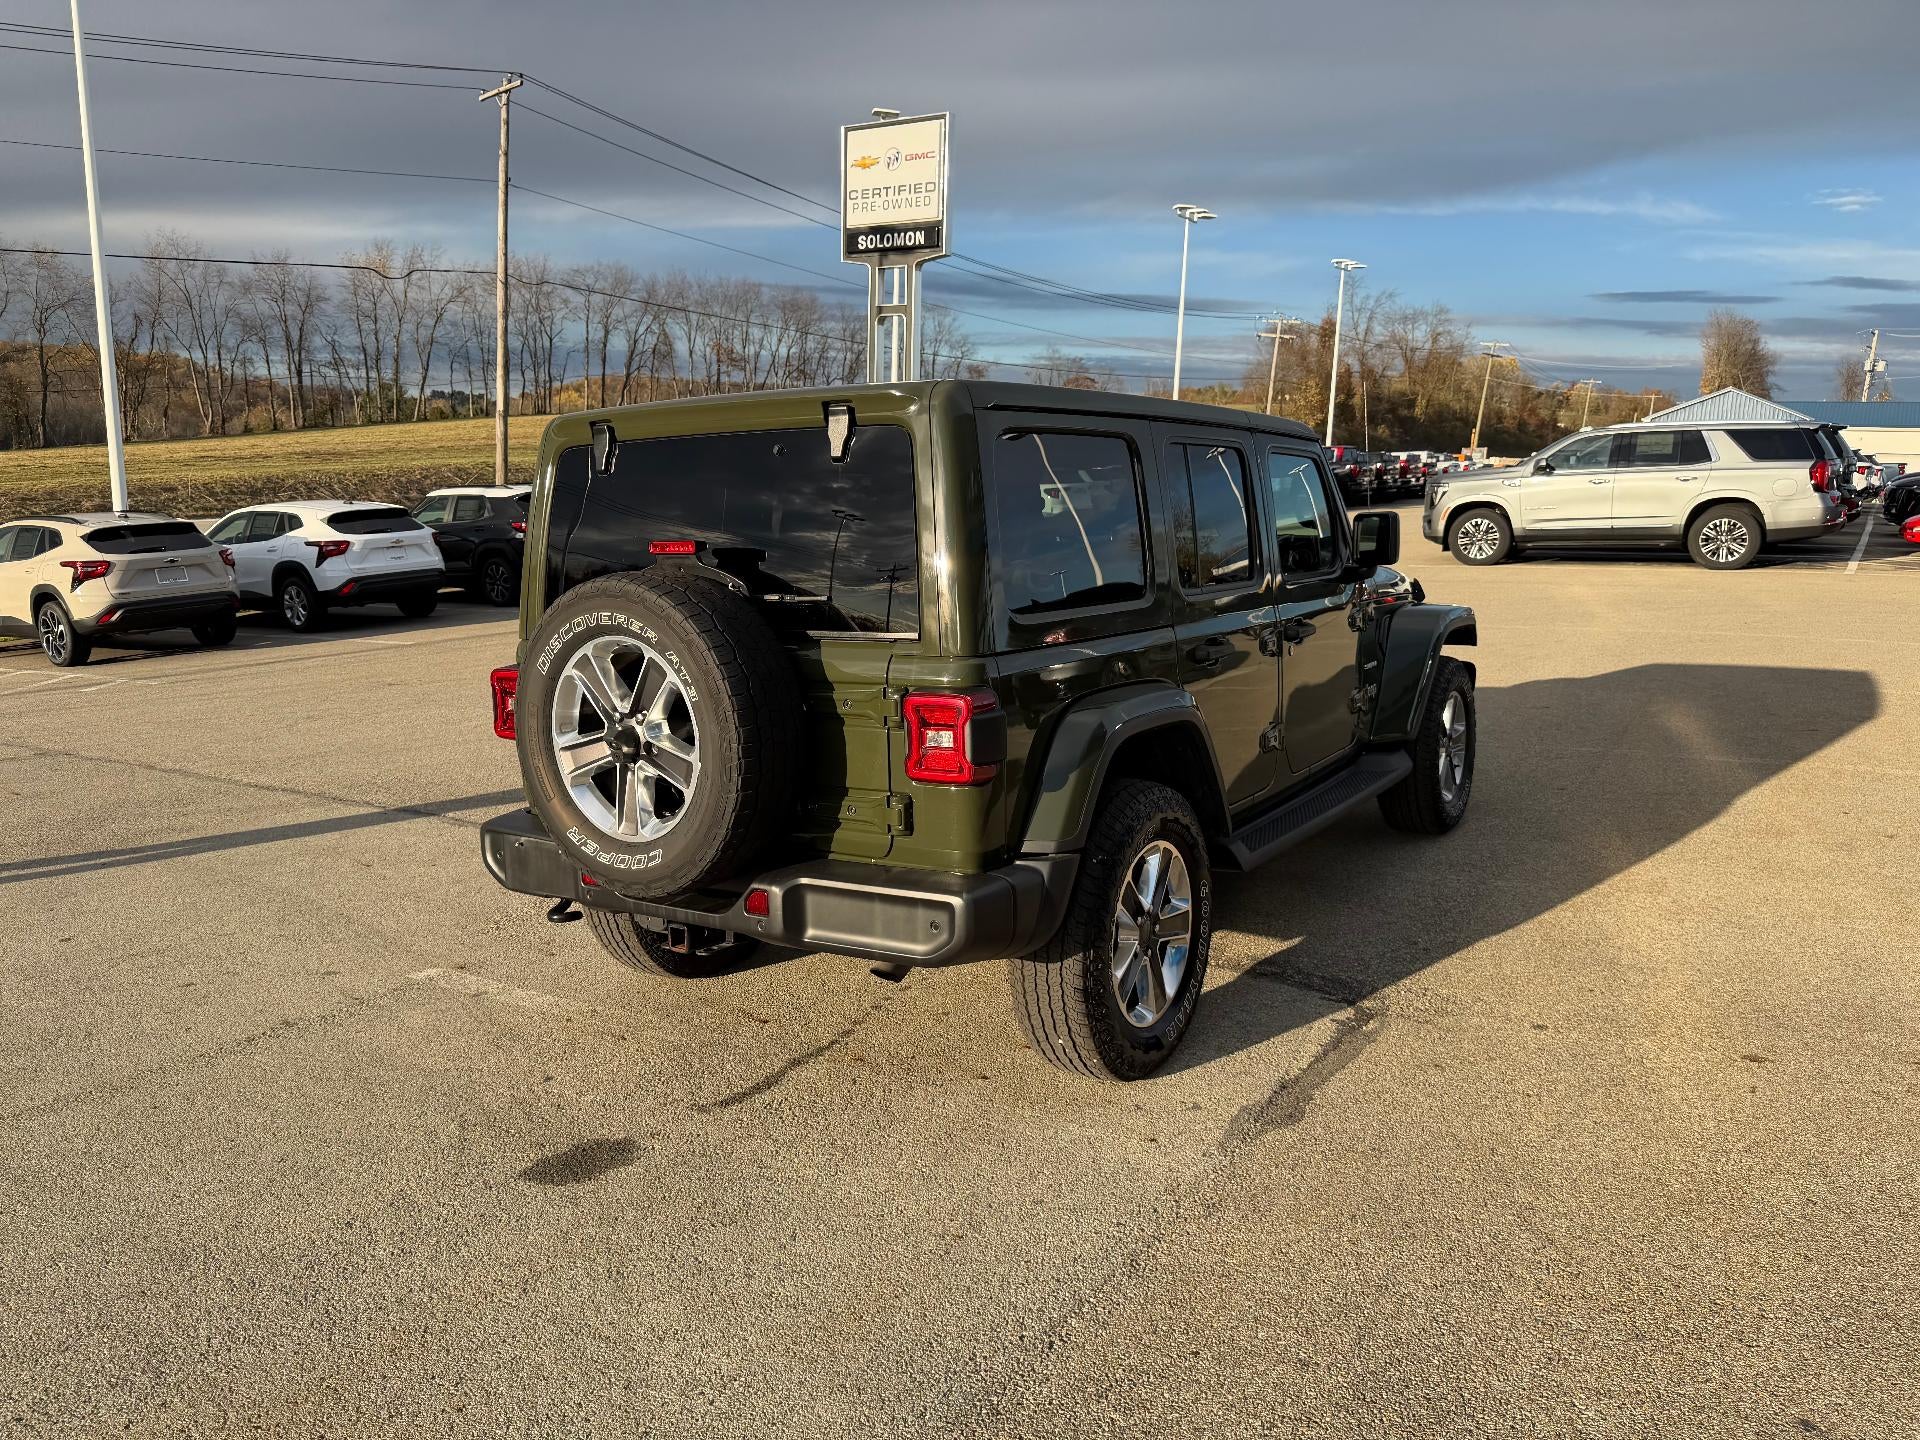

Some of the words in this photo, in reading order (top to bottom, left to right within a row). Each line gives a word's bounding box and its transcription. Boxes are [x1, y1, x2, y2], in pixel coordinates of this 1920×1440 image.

[904, 151, 936, 162] GMC
[849, 181, 936, 201] CERTIFIED
[852, 195, 931, 214] PRE-OWNED
[857, 230, 925, 250] SOLOMON
[537, 612, 658, 676] DISCOVERER
[566, 825, 663, 869] COOPER
[1165, 879, 1209, 1041] GOODYEAR
